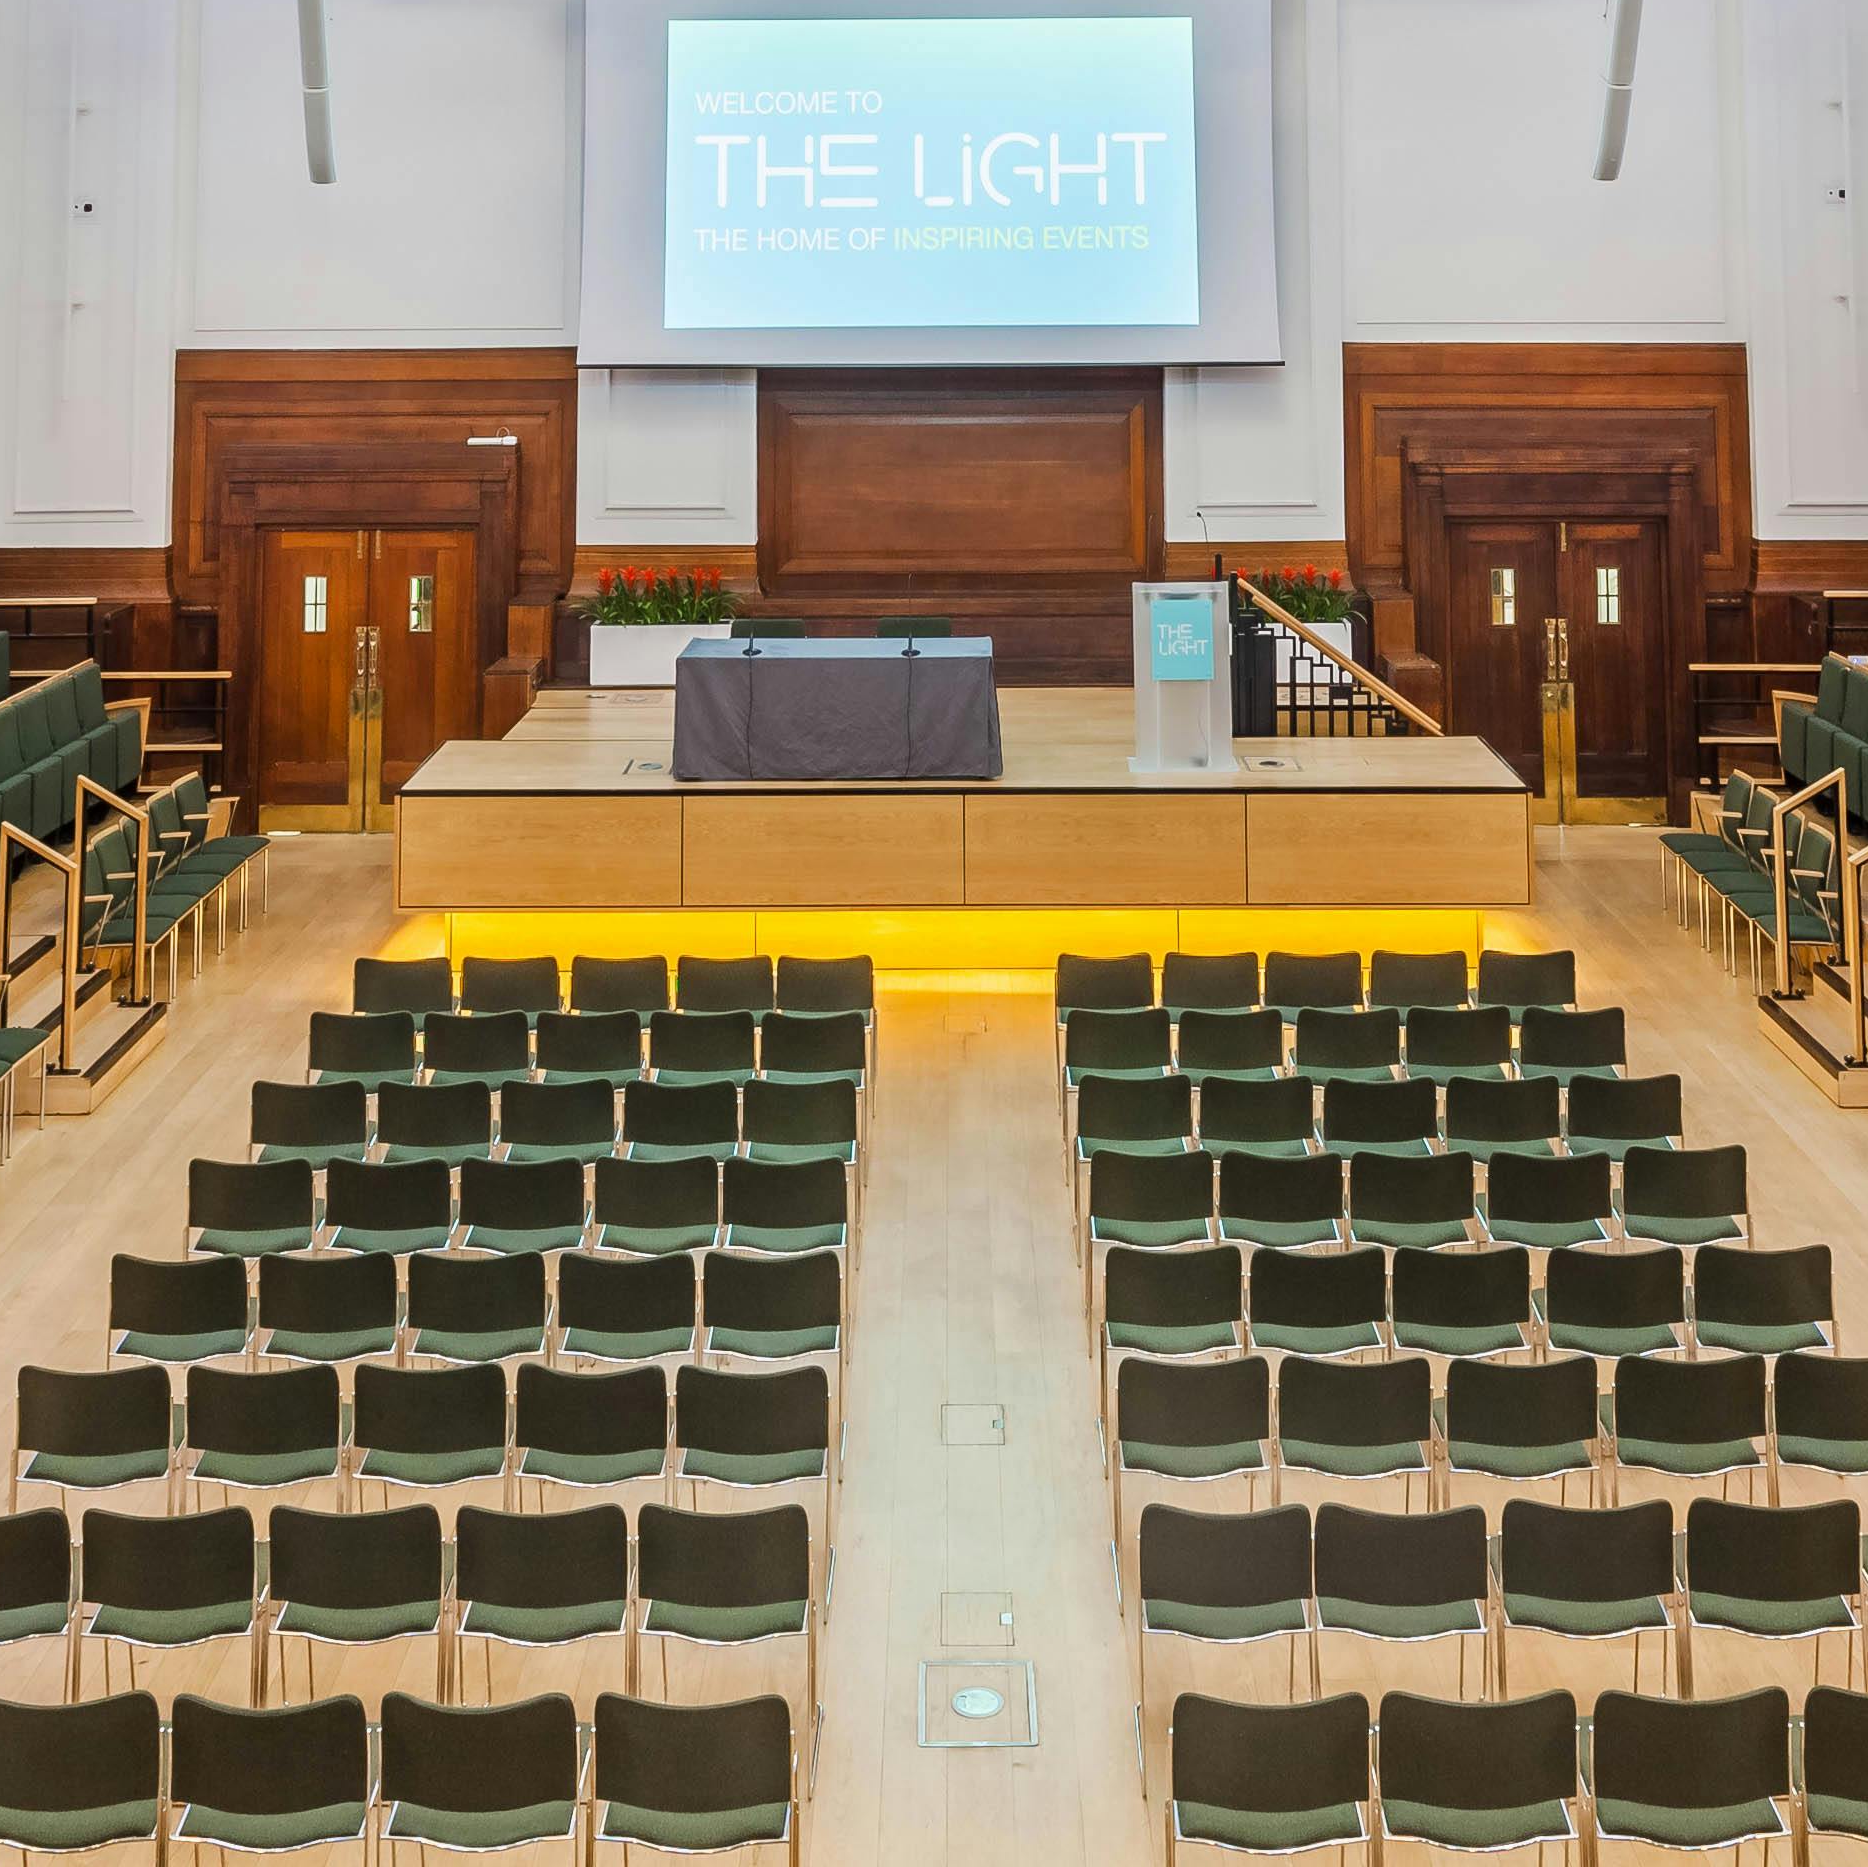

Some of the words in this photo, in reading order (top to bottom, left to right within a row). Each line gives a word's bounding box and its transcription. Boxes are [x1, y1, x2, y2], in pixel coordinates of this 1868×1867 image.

[694, 90, 839, 115] WELCOME
[844, 90, 884, 115] TO
[694, 133, 880, 209] THE
[693, 227, 749, 252] THE
[756, 227, 841, 251] HOME
[848, 226, 887, 251] OF
[893, 225, 1035, 251] INSPIRING
[1042, 224, 1150, 250] EVENTS
[1157, 623, 1192, 639] THE
